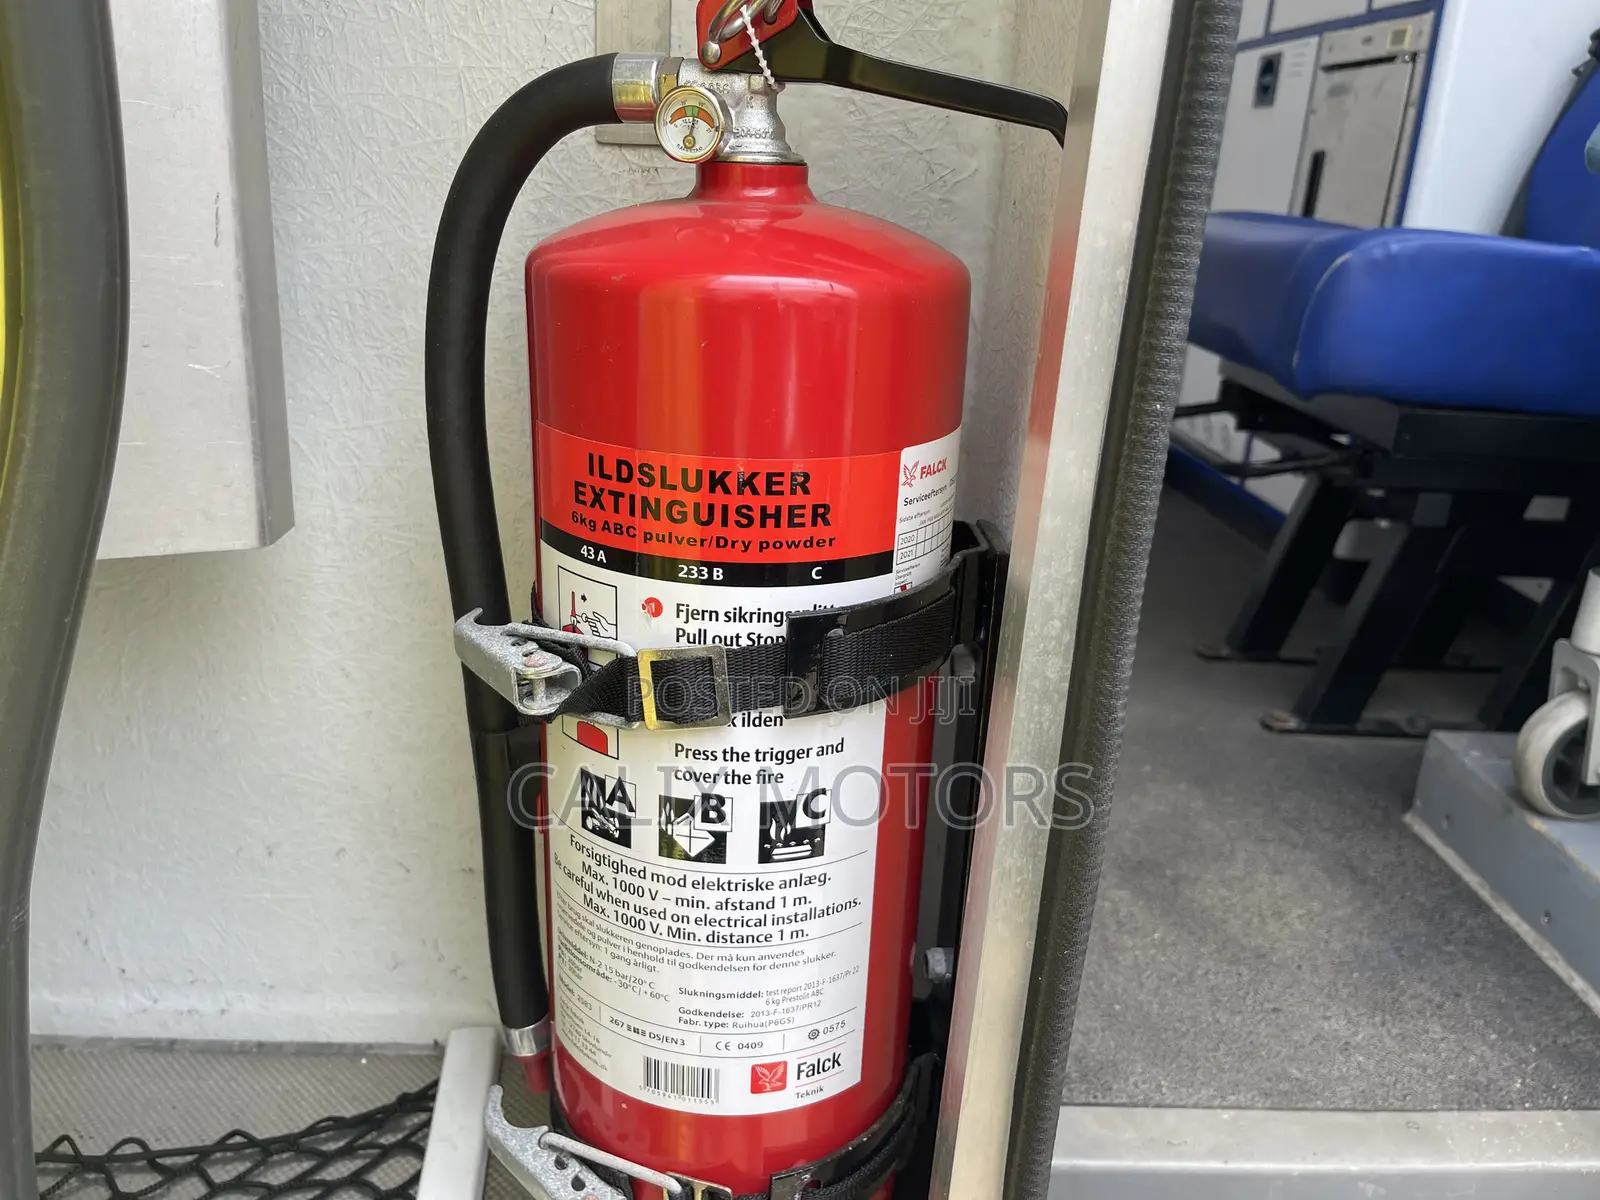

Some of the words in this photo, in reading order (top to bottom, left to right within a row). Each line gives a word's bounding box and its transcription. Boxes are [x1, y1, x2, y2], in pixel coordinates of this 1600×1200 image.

[588, 453, 811, 496] ILDSLUKKER
[920, 457, 948, 480] FALCK
[574, 480, 831, 529] EXTINGUISHER
[572, 511, 596, 532] 6kg
[601, 522, 637, 539] ABC
[644, 530, 752, 552] pulver/Dry
[759, 536, 836, 552] powder
[900, 534, 916, 546] 2020
[580, 544, 595, 560] 43
[596, 550, 607, 564] A
[900, 550, 914, 560] 2021
[678, 564, 708, 580] 233
[713, 568, 724, 580] B
[811, 566, 822, 580] C
[676, 602, 719, 624] Fjern
[676, 627, 707, 646] Pull
[711, 632, 742, 647] out
[742, 712, 784, 728] ilden
[674, 743, 718, 762] Press
[722, 746, 750, 763] the
[754, 744, 814, 766] trigger
[817, 738, 844, 757] and
[674, 769, 720, 784] cover
[724, 770, 752, 785] the
[756, 769, 784, 785] fire
[604, 776, 635, 813] A
[802, 788, 828, 820] C
[700, 793, 726, 824] B
[570, 834, 646, 880] Forsigtighed
[651, 874, 686, 888] mod
[691, 876, 774, 892] elektriske
[778, 872, 832, 890] anlæg.
[582, 860, 608, 886] Max.
[612, 877, 645, 898] 1000
[648, 888, 659, 902] V
[675, 896, 710, 910] min.
[714, 896, 776, 911] afstand
[780, 896, 788, 908] 1
[792, 895, 812, 907] m.
[563, 866, 594, 894] careful
[596, 887, 630, 910] when
[634, 904, 667, 922] used
[670, 912, 690, 926] on
[694, 914, 767, 928] electrical
[772, 897, 862, 926] installations.
[583, 894, 610, 918] Max.
[614, 910, 646, 932] 1000
[650, 921, 662, 936] V.
[667, 926, 702, 942] Min.
[706, 930, 772, 944] distance
[778, 928, 784, 941] 1
[790, 928, 809, 940] m.
[582, 913, 594, 927] skal
[596, 922, 634, 946] slukkeren
[636, 941, 694, 960] genoplades.
[696, 952, 714, 961] Der
[716, 952, 734, 962] må
[736, 952, 756, 962] kun
[758, 949, 805, 961] anvendes
[597, 932, 622, 950] pulver
[627, 946, 665, 964] henhold
[667, 958, 676, 966] til
[678, 961, 750, 972] godkendelsen
[752, 962, 766, 972] for
[768, 960, 800, 970] denne
[610, 950, 631, 966] gang
[604, 964, 614, 974] 15
[678, 987, 764, 1000] Slukningsmiddel:
[766, 989, 780, 997] test
[780, 985, 802, 996] report
[772, 997, 780, 1006] kg
[811, 988, 824, 998] ABC
[609, 1016, 624, 1028] 267
[678, 1007, 744, 1018] Godkendelse:
[678, 1017, 702, 1027] Fabr.
[704, 1020, 729, 1030] type:
[822, 1020, 846, 1036] 0575
[738, 1042, 764, 1050] 0409
[796, 1052, 842, 1080] Falck
[796, 1085, 824, 1100] Teknik
